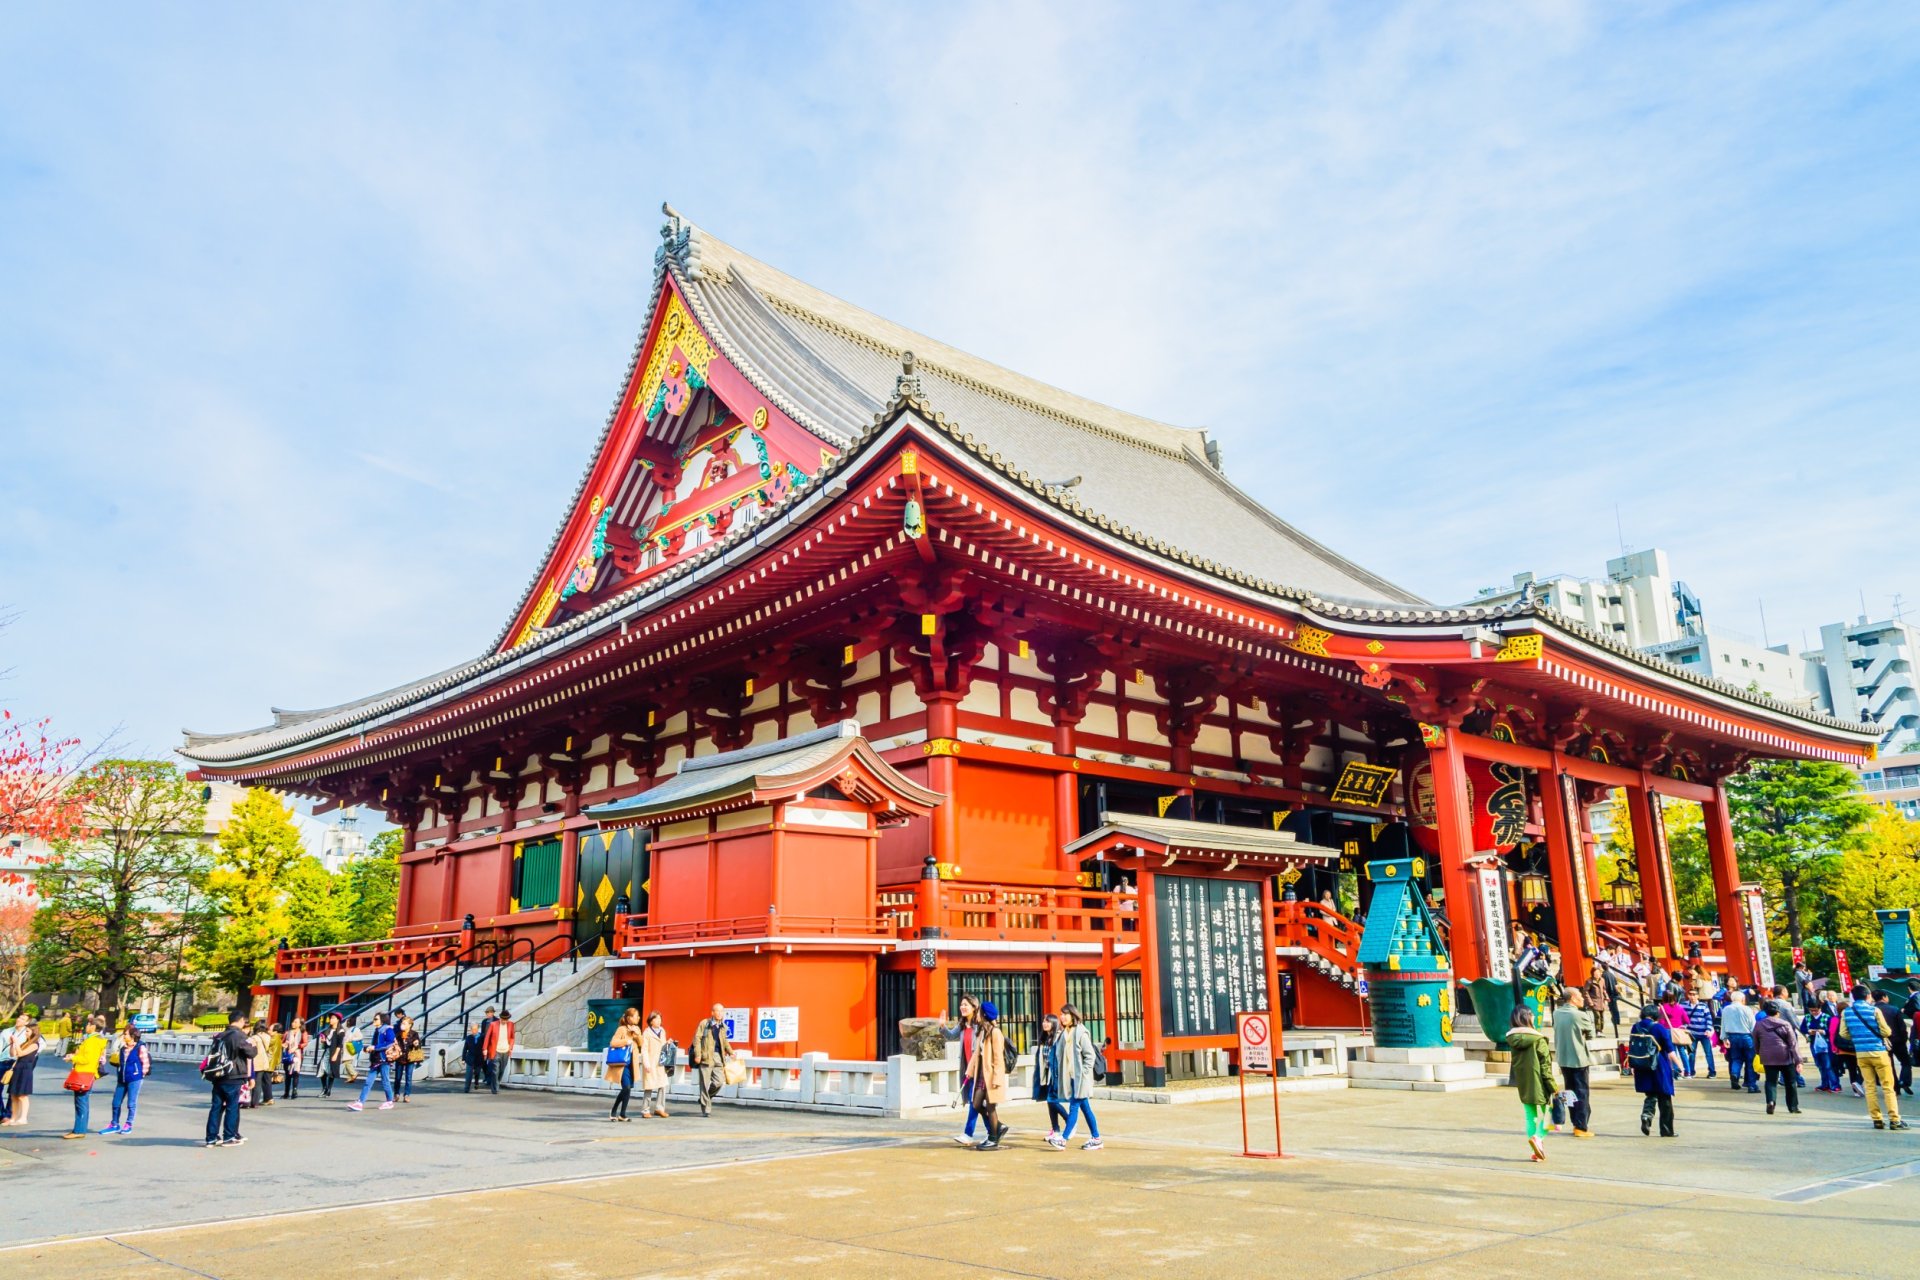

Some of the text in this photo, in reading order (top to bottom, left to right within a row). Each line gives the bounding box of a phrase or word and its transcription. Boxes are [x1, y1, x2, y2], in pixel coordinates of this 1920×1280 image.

[1250, 897, 1268, 1010] 本堂連日法会
